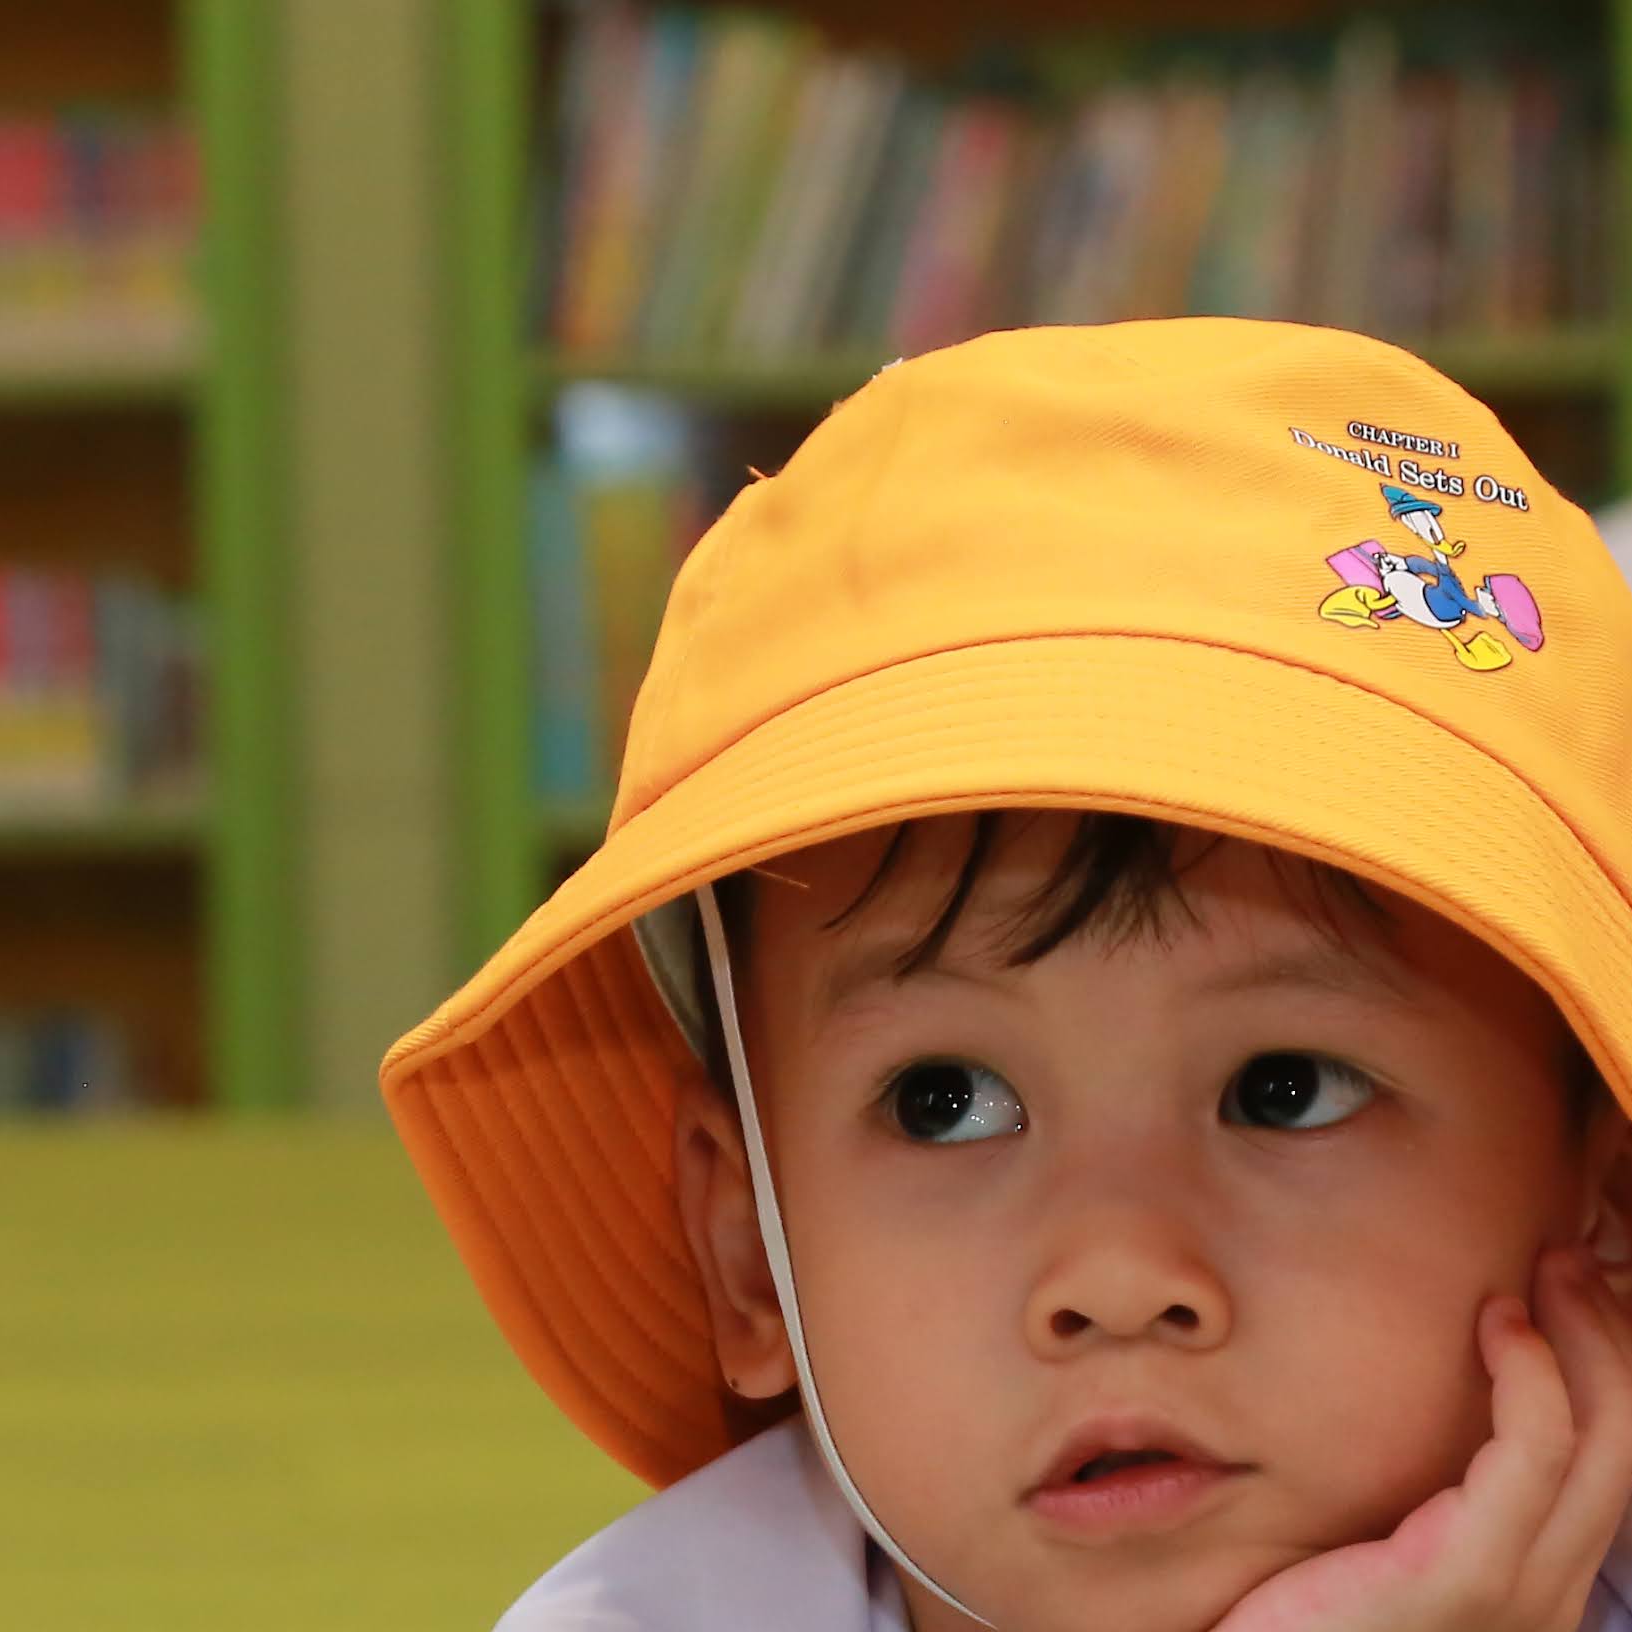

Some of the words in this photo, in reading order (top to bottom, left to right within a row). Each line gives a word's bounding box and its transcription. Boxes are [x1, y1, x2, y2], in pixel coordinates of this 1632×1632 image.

[1347, 421, 1444, 457] CHAPTER
[1290, 427, 1392, 478] Donald
[1399, 459, 1464, 496] Sets
[1473, 475, 1530, 512] Out
